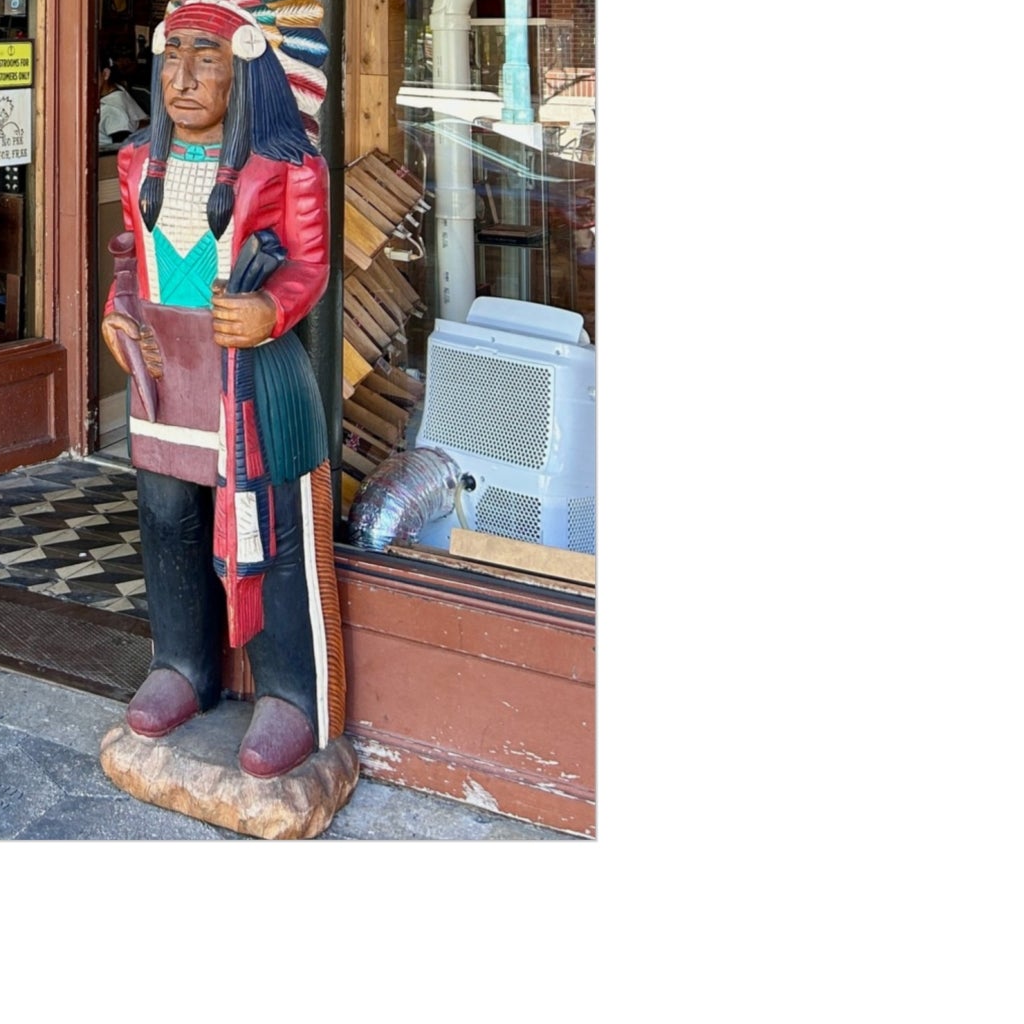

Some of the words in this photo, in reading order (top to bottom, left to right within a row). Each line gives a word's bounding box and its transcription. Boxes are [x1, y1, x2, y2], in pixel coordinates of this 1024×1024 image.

[20, 58, 29, 68] FOR
[18, 71, 30, 81] ONLY
[2, 137, 12, 147] NO
[12, 148, 27, 159] FREE
